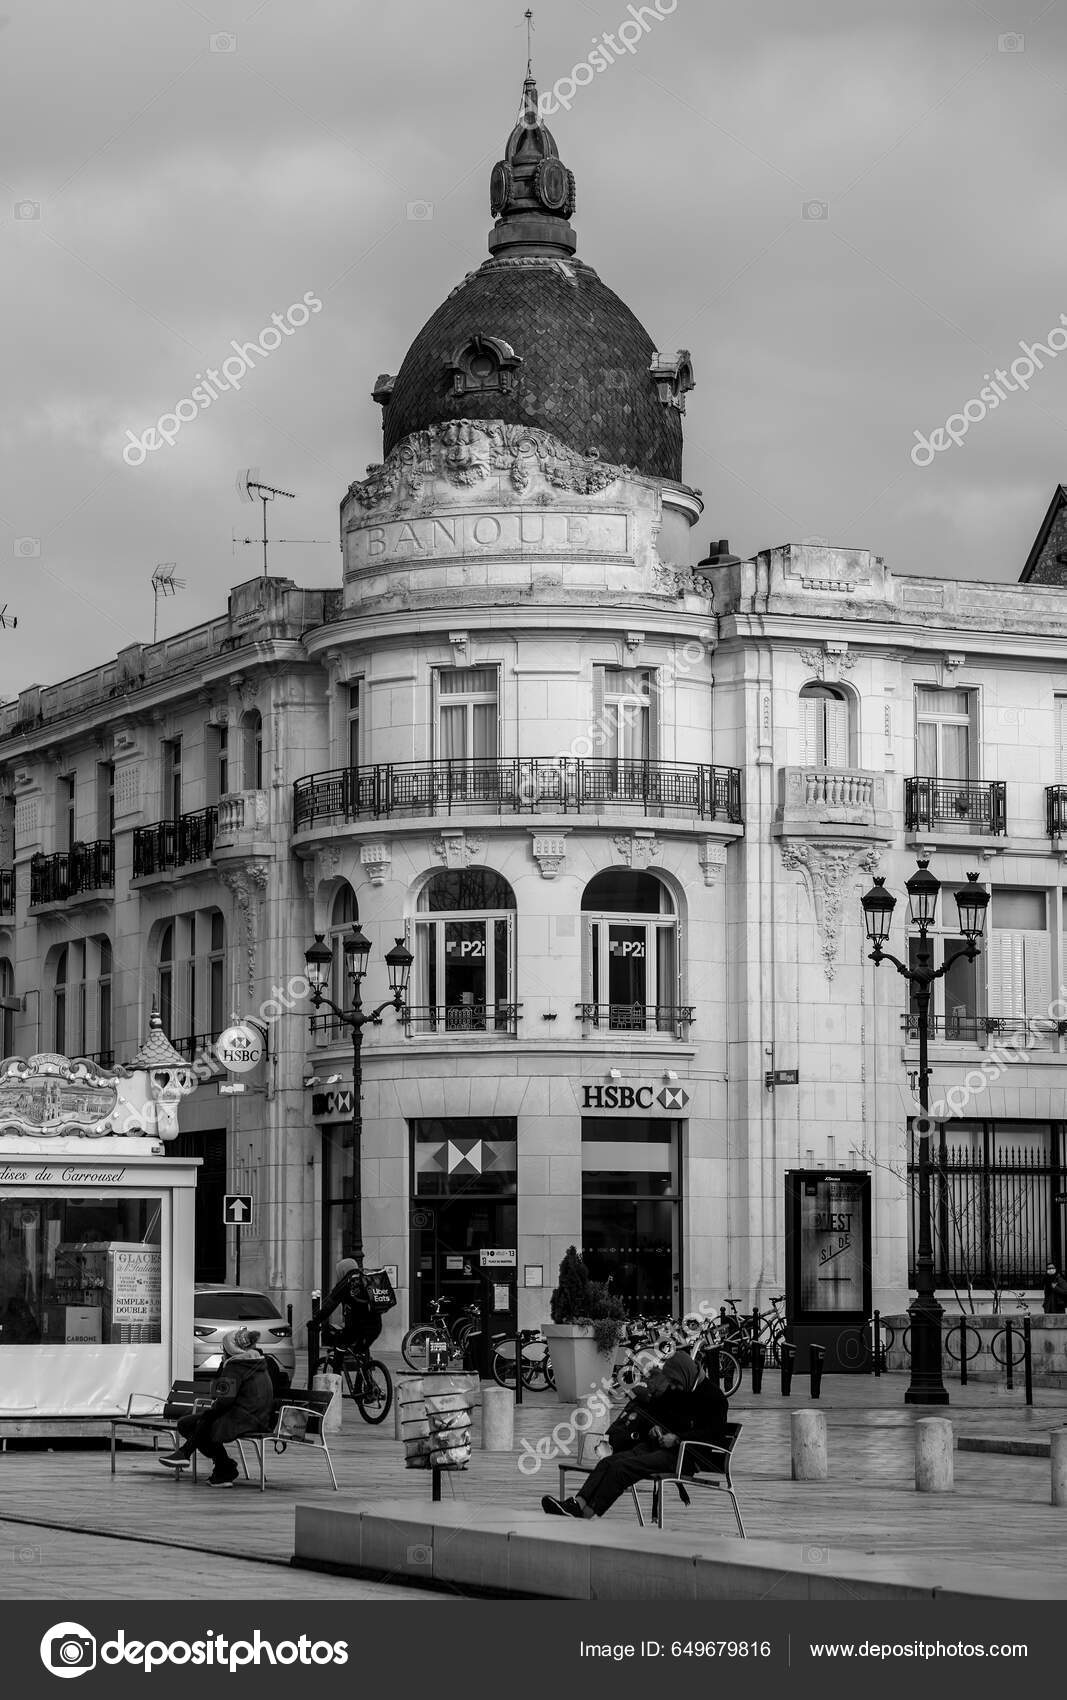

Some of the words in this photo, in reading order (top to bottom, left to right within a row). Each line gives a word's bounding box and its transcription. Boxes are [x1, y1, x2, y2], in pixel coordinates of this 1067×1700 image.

[461, 941, 485, 957] P2i
[622, 941, 645, 957] P2i
[223, 1050, 259, 1061] HSBC
[582, 1085, 654, 1109] HSBC
[35, 1166, 52, 1181] du
[62, 1166, 126, 1182] Carrousel
[116, 1298, 145, 1306] SIMPLE
[116, 1306, 147, 1314] DOUBLE
